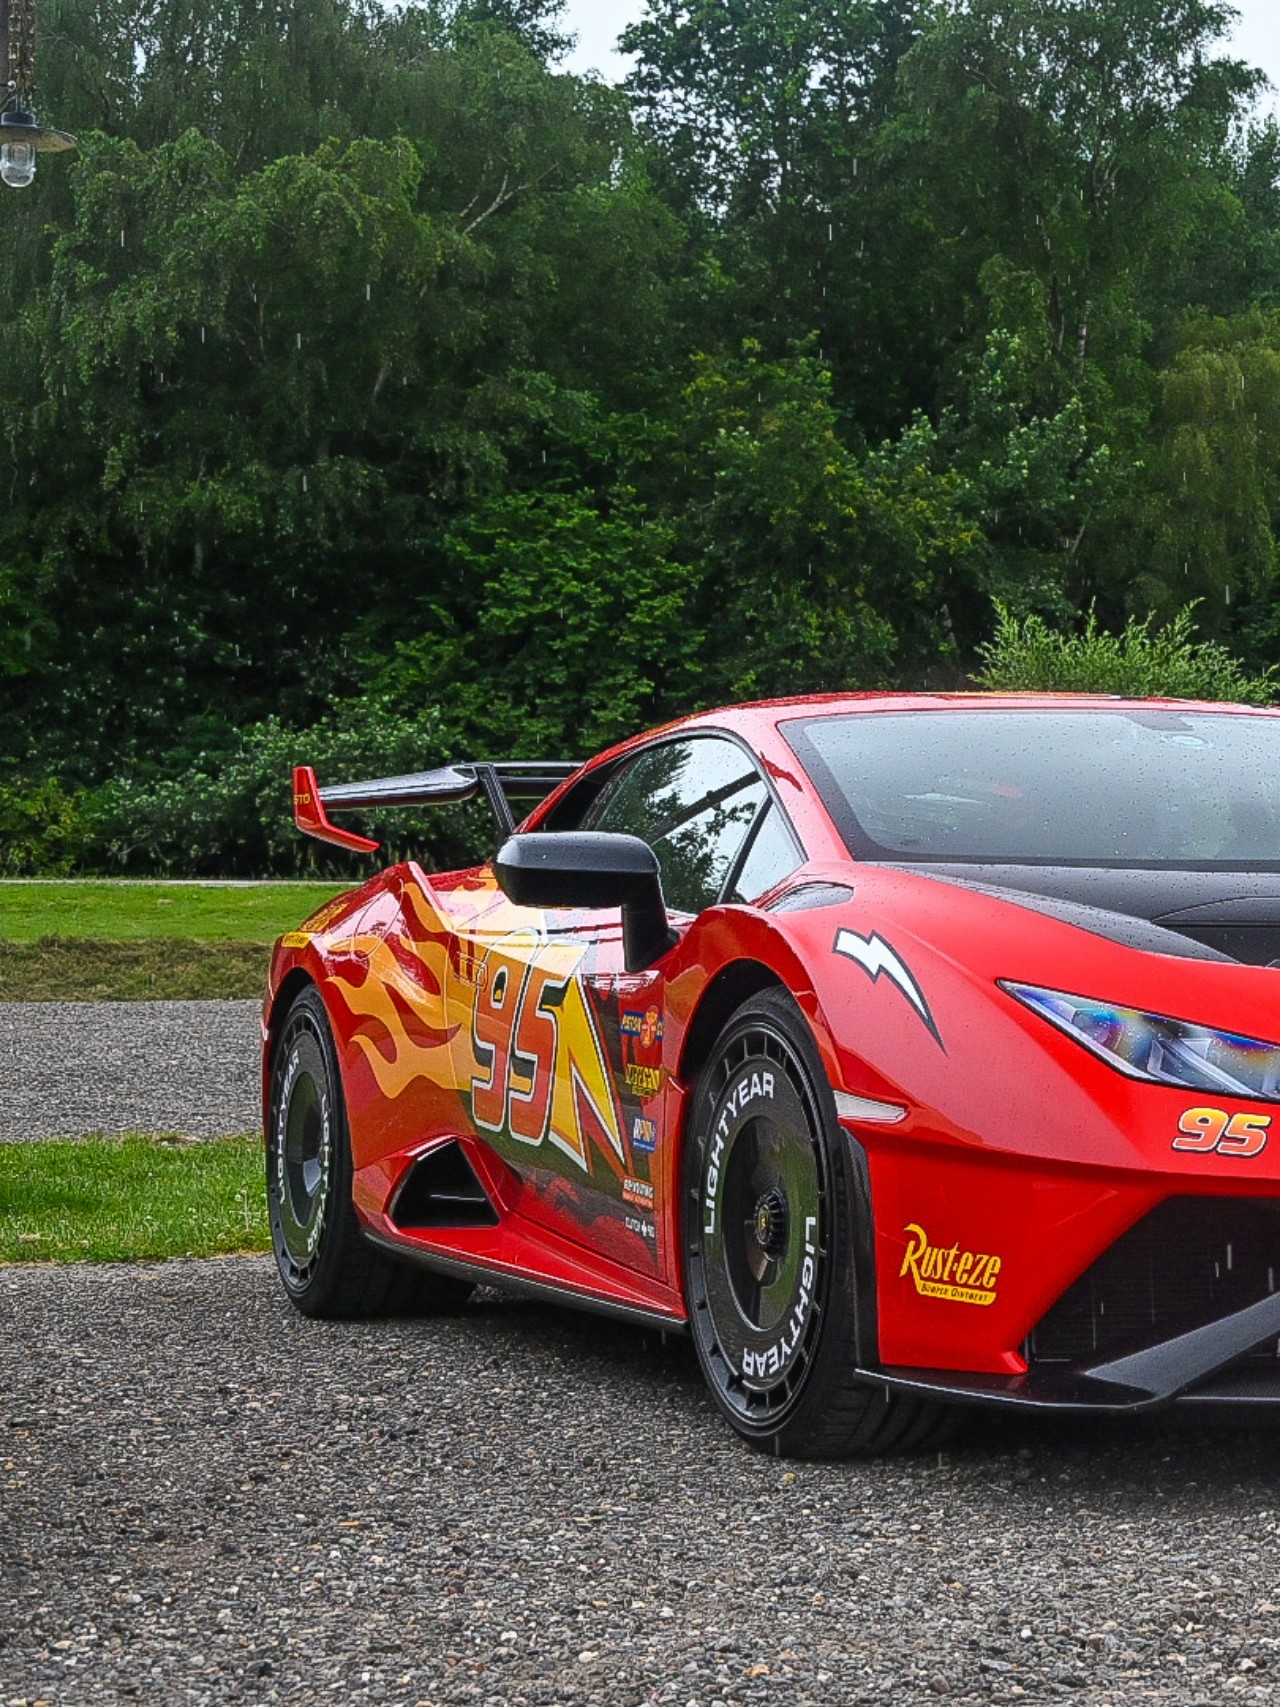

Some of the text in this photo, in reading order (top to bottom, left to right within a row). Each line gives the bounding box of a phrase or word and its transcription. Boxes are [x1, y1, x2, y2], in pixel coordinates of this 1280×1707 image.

[472, 926, 590, 1147] 95
[705, 1071, 774, 1234] LIGHTYEAR
[1171, 1106, 1273, 1159] 95
[742, 1216, 816, 1376] LIGHTYEAR
